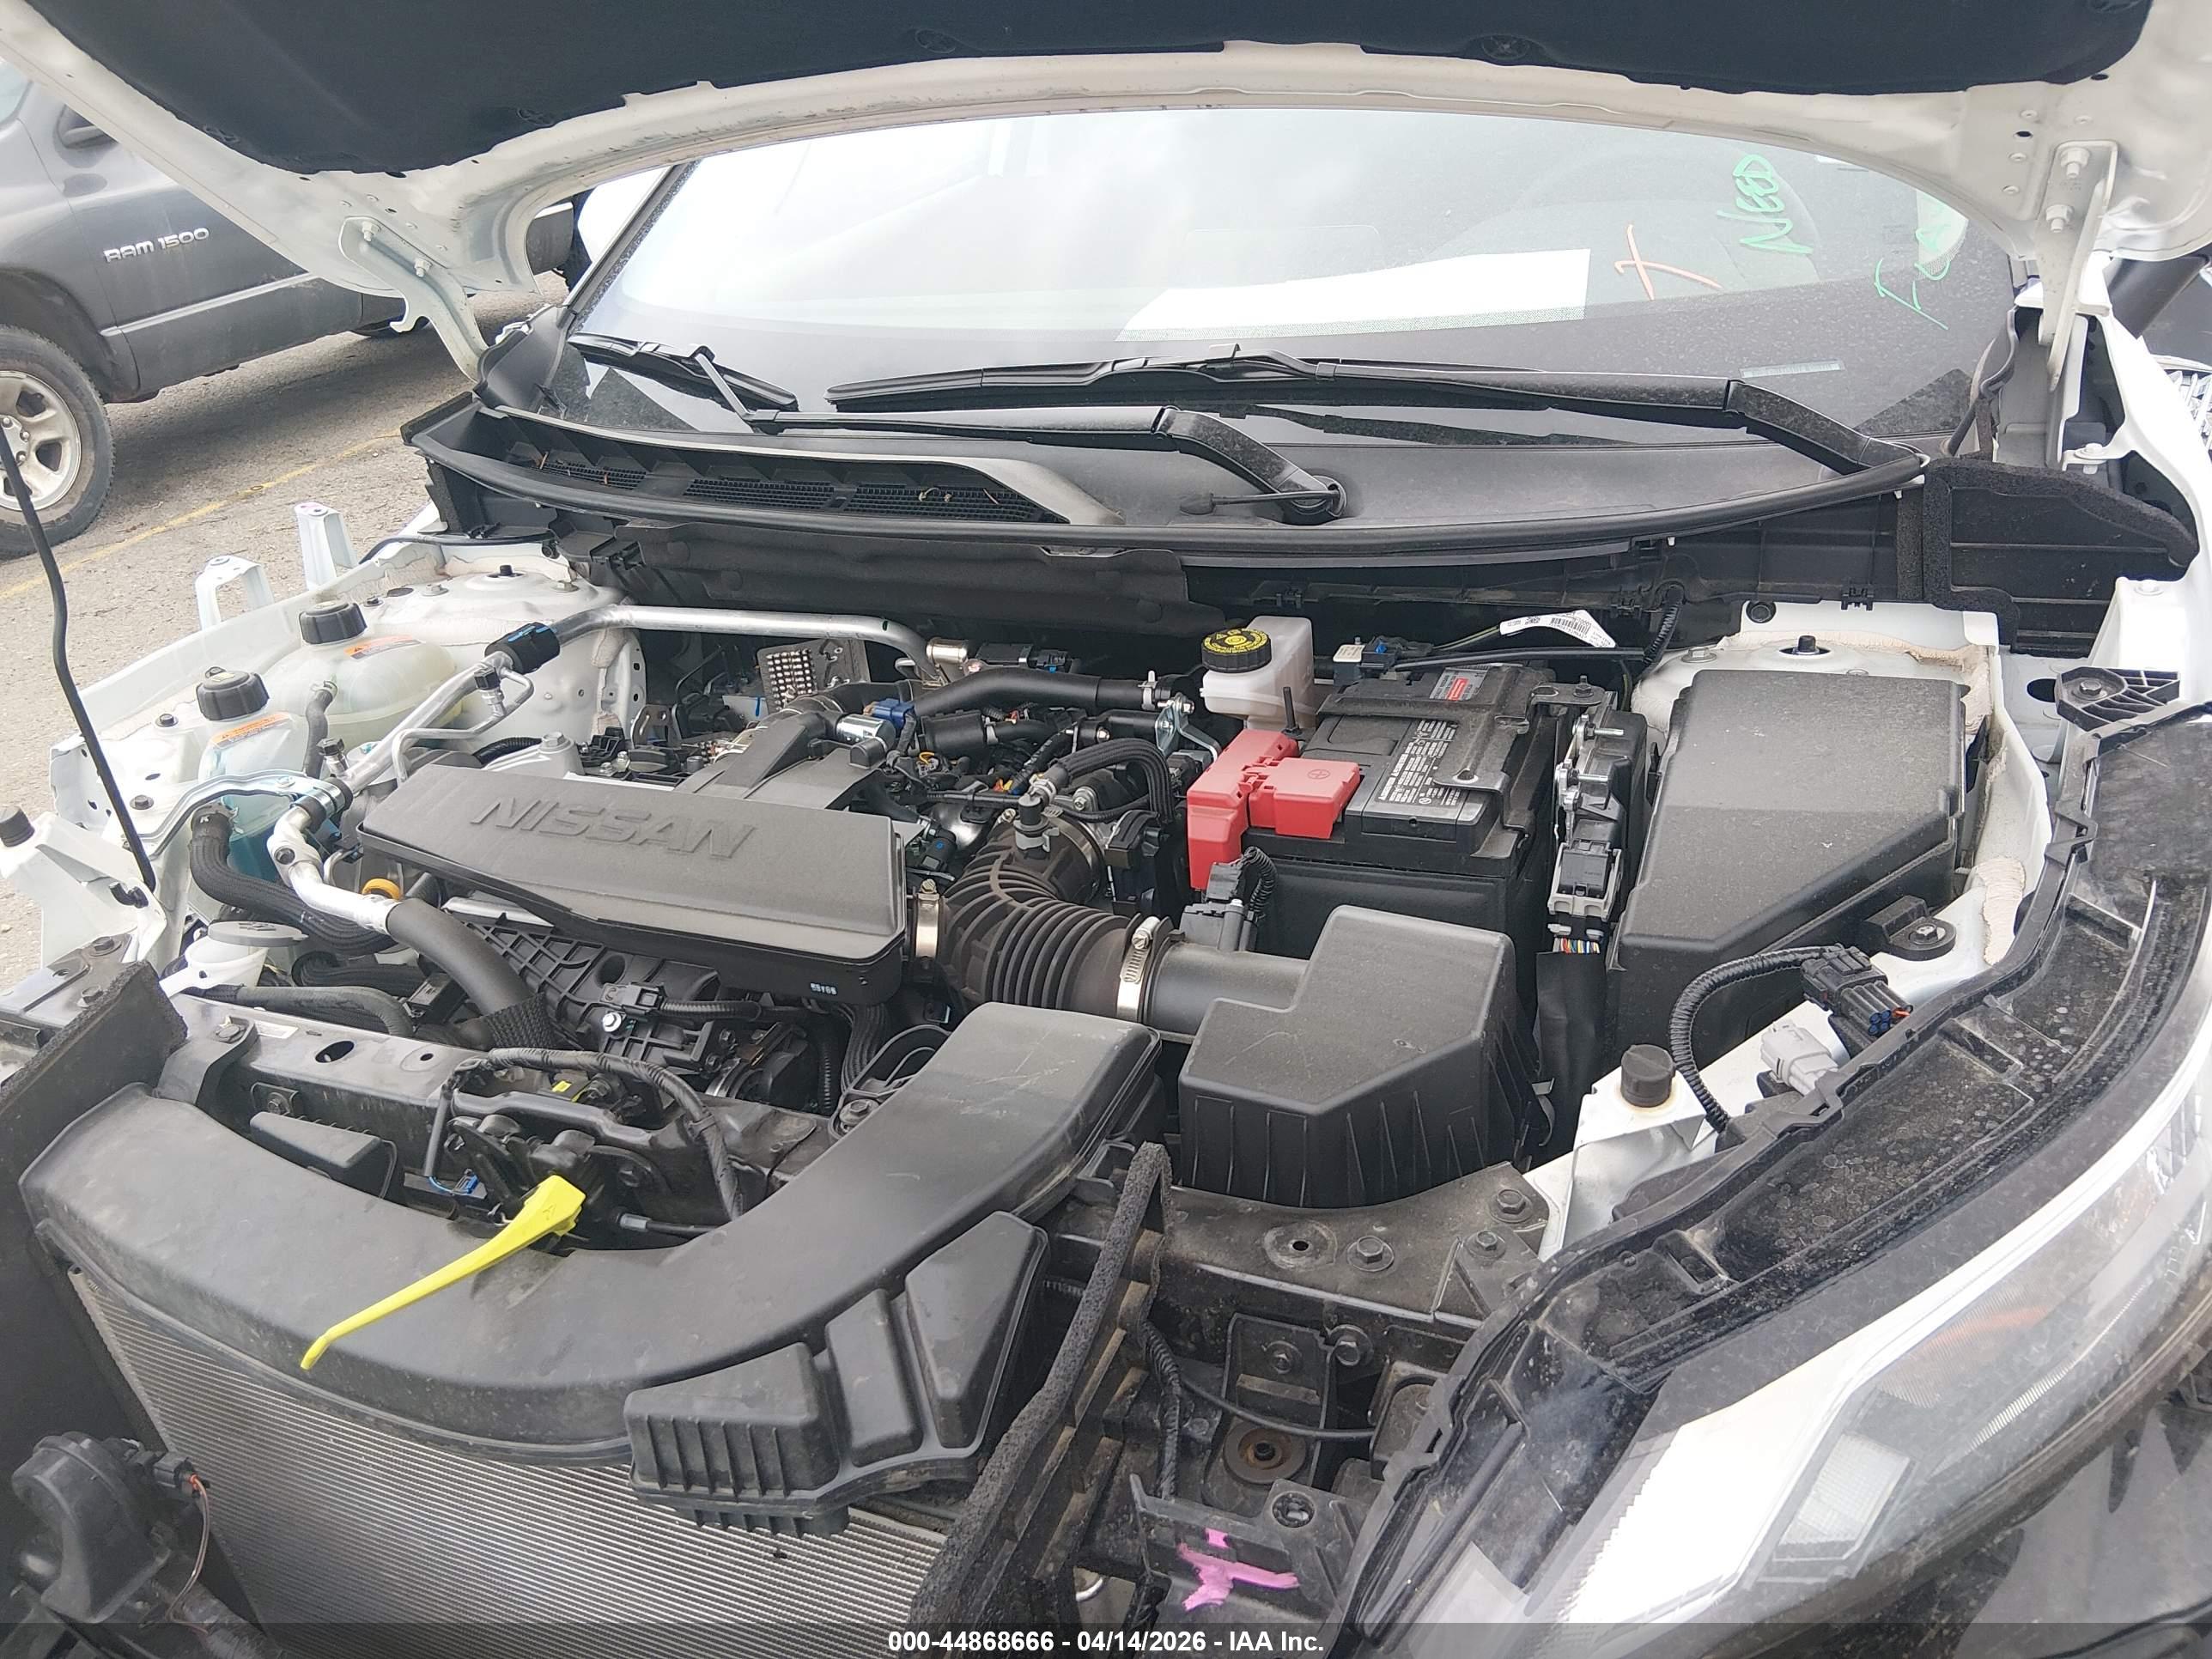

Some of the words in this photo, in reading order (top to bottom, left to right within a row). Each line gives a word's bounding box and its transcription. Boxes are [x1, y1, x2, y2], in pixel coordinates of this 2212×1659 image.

[103, 240, 155, 263] RAM
[157, 227, 210, 250] 1500
[470, 797, 757, 860] NISSAN
